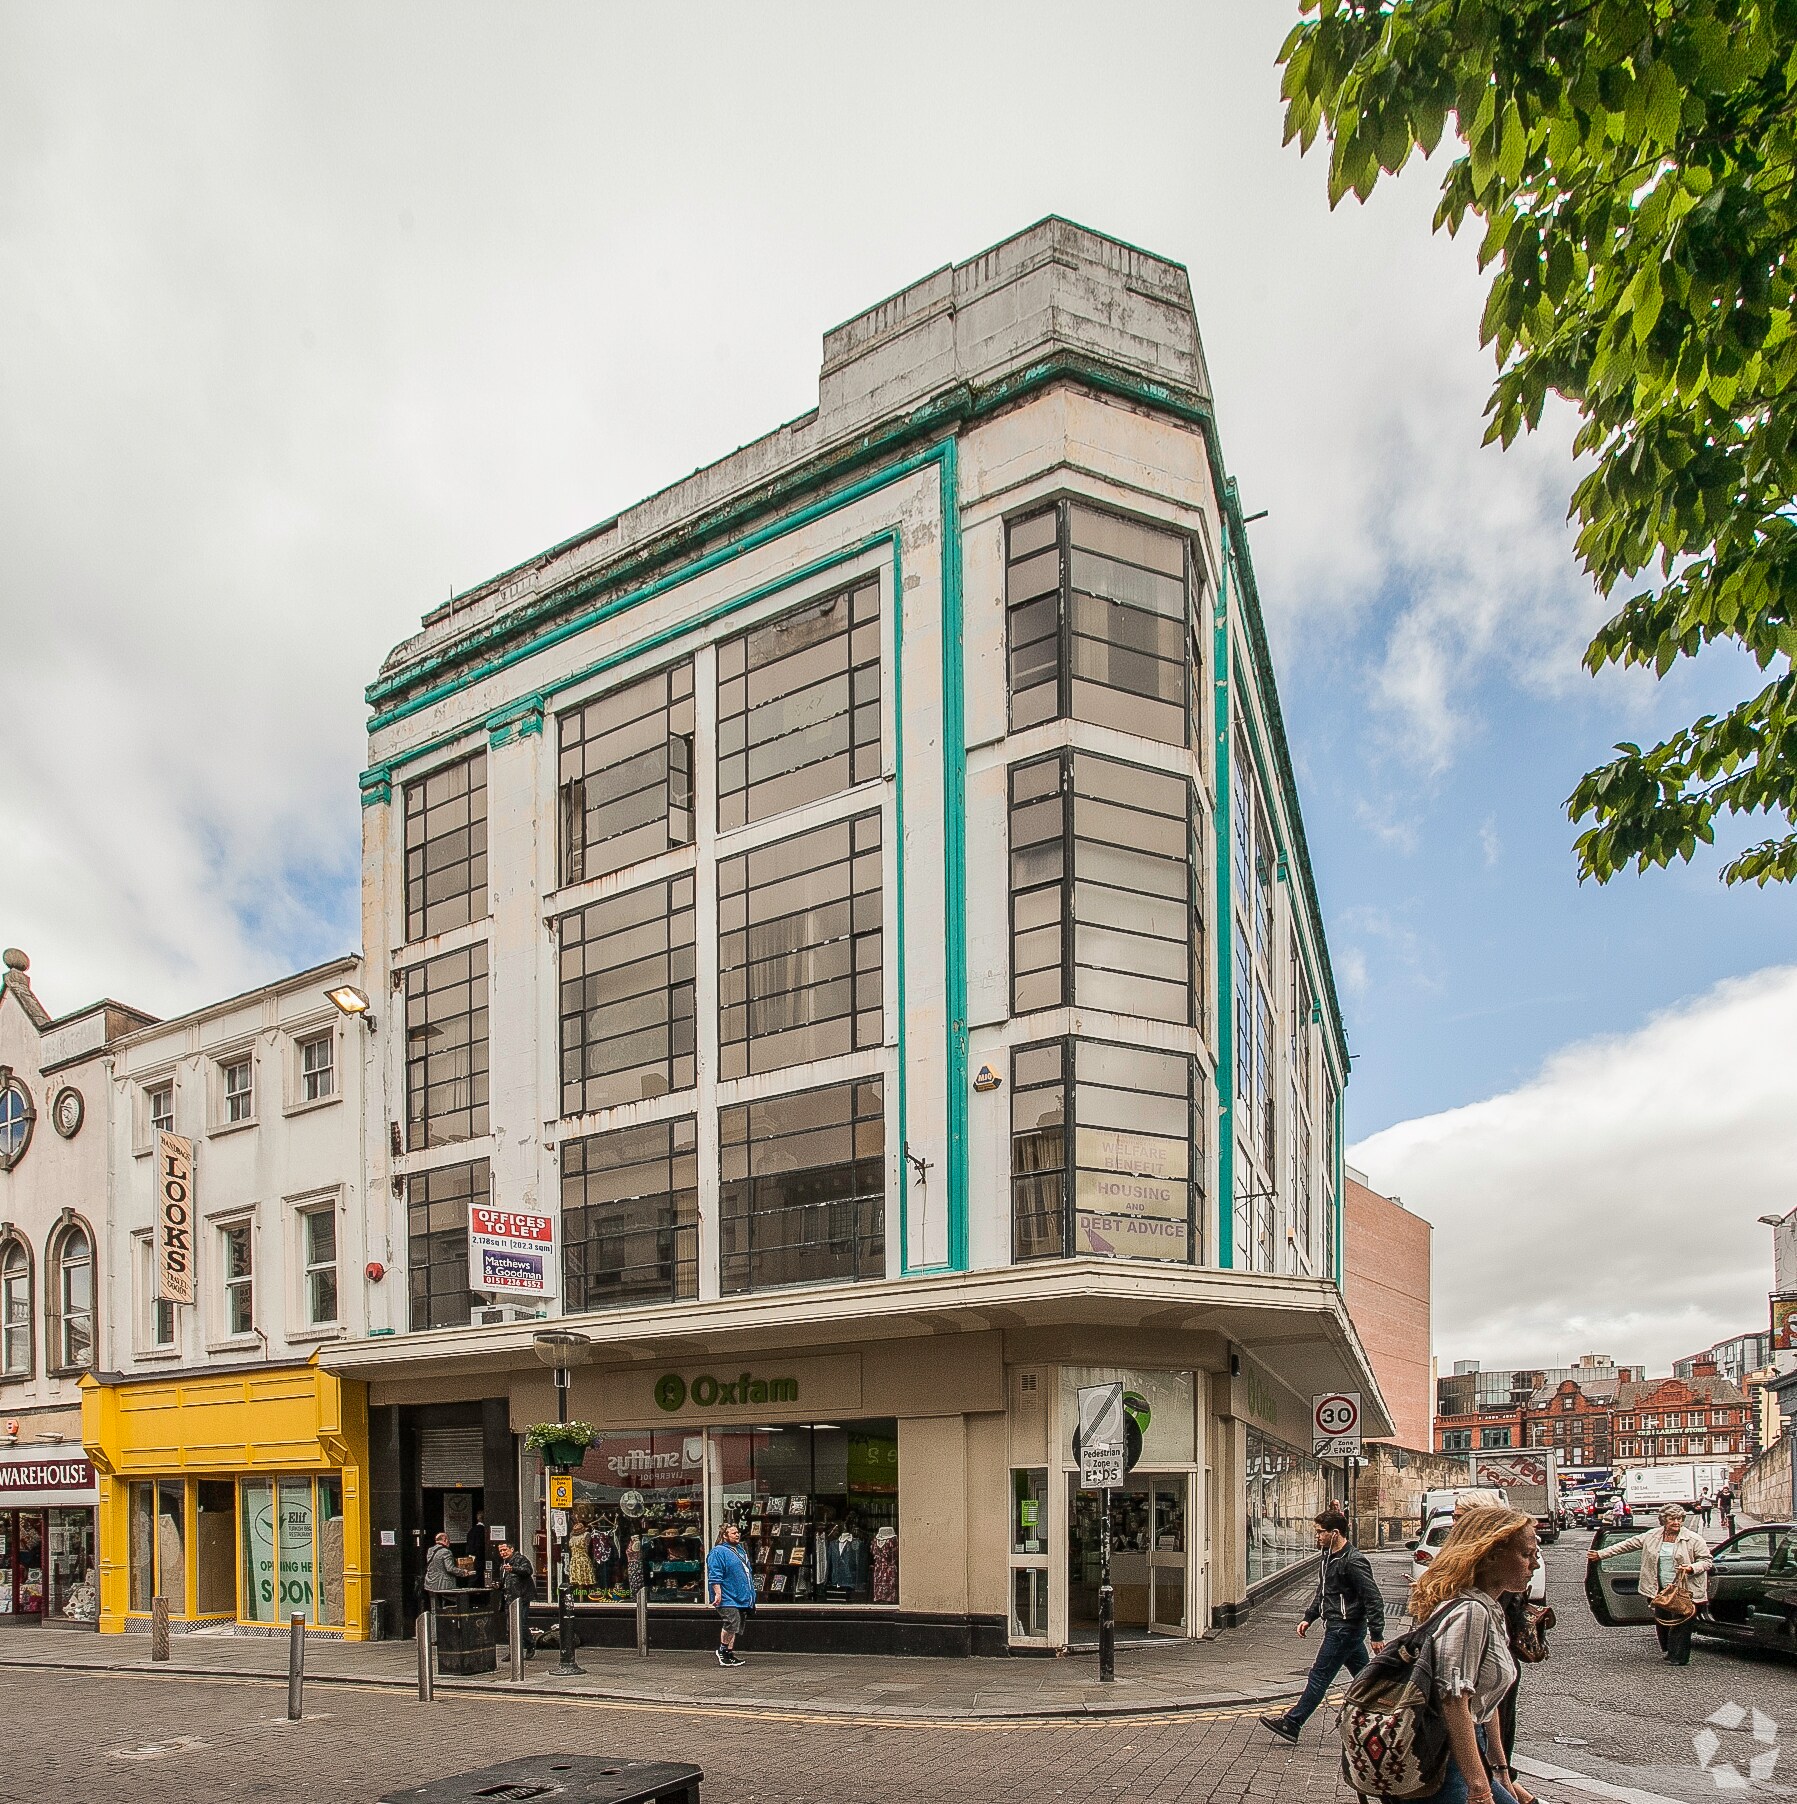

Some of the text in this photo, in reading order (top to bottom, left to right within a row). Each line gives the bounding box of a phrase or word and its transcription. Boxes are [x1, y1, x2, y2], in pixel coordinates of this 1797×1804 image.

[1102, 1142, 1166, 1160] WELFARE
[1104, 1157, 1164, 1174] BENEFIT
[1097, 1182, 1171, 1201] HOUSING
[164, 1155, 189, 1273] LOOKS
[1126, 1203, 1145, 1211] AND
[478, 1211, 546, 1229] OFFICES
[1080, 1216, 1185, 1238] DEBT ADVICE
[485, 1221, 540, 1238] TO LET
[485, 1256, 530, 1269] Matthews
[485, 1266, 541, 1280] & Goodman
[486, 1276, 541, 1289] 0151 236 4552
[690, 1373, 799, 1407] Oxfam
[1321, 1407, 1352, 1424] 30
[1083, 1448, 1121, 1459] Pedestrian
[1093, 1460, 1111, 1468] Zone
[0, 1464, 88, 1486] WAREHOUSE
[1085, 1468, 1118, 1482] EDS
[288, 1511, 307, 1524] Elif
[301, 1561, 322, 1573] HEE
